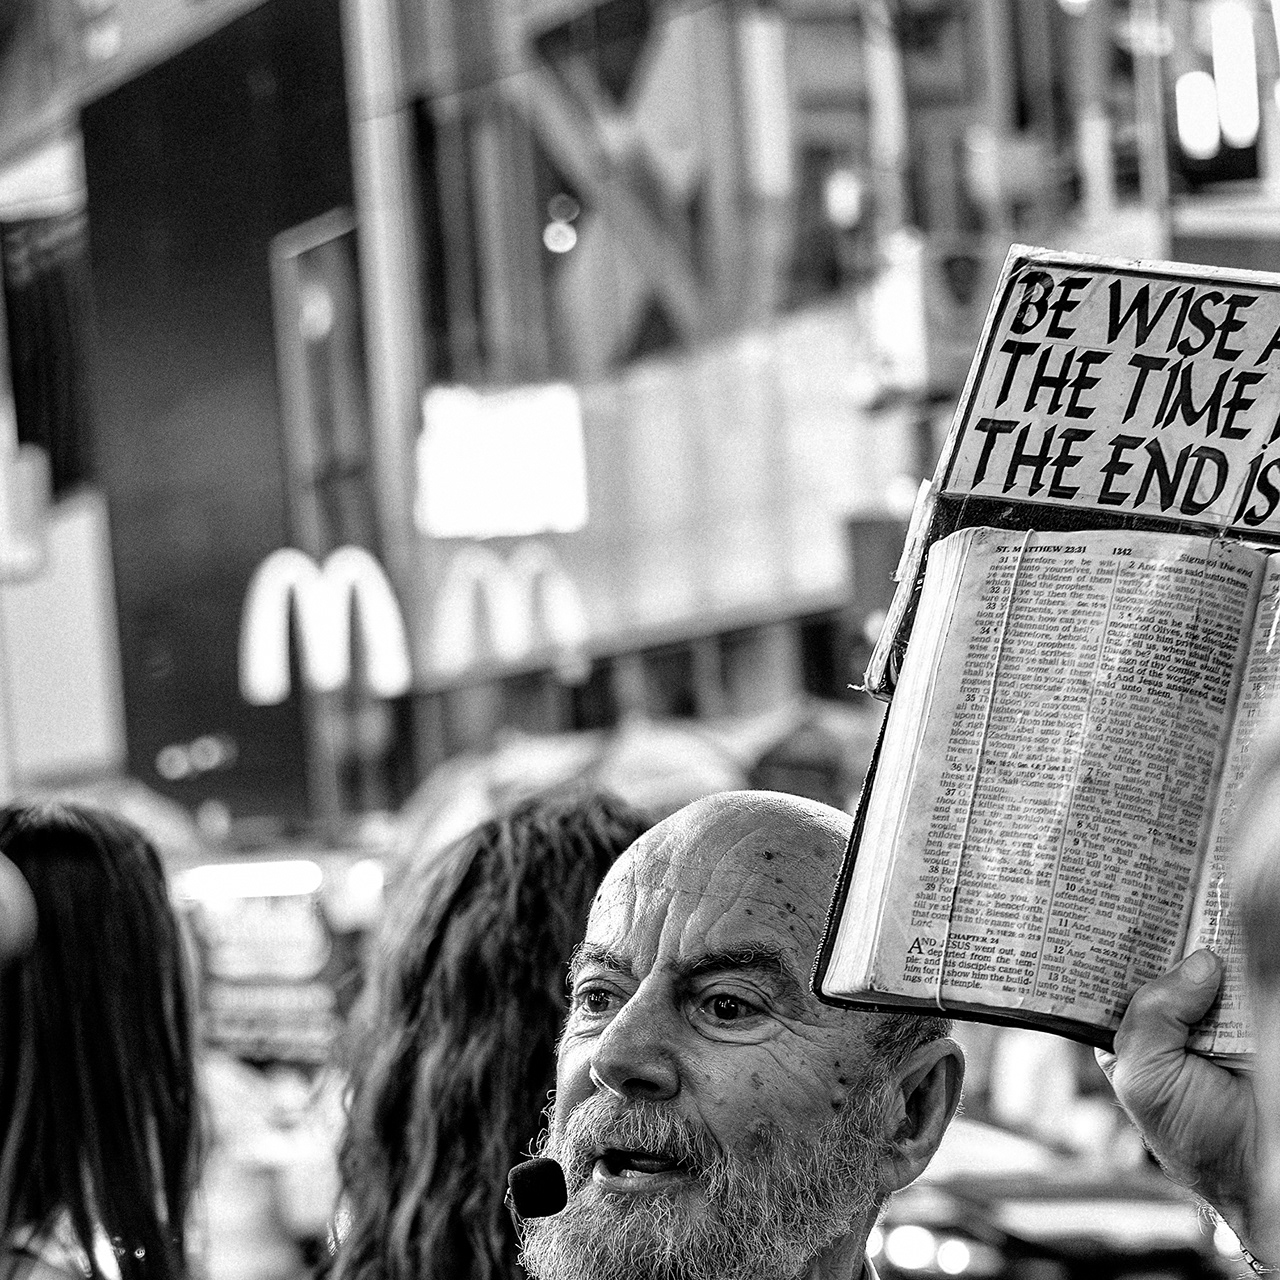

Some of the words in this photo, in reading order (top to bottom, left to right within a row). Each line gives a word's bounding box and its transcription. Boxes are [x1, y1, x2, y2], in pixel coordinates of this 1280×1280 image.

[1010, 270, 1092, 339] BE
[1108, 278, 1257, 361] WISE
[996, 340, 1110, 417] THE
[1127, 355, 1266, 440] TIME
[970, 419, 1095, 498] THE
[1097, 435, 1228, 515] END
[1220, 562, 1235, 571] the
[1237, 568, 1253, 578] end
[1153, 625, 1182, 637] Olives,
[1122, 685, 1142, 693] unto
[1067, 883, 1076, 891] 10
[1078, 886, 1098, 896] And
[1059, 919, 1068, 927] 11
[1072, 922, 1091, 932] And
[908, 937, 936, 955] AND
[999, 948, 1015, 956] out,
[1021, 951, 1038, 959] and
[1054, 946, 1064, 954] 12
[1067, 949, 1086, 959] And
[970, 953, 991, 962] from
[997, 956, 1010, 964] the
[905, 964, 921, 973] him
[972, 971, 988, 980] him
[991, 974, 1004, 982] the
[959, 961, 996, 971] disciples
[999, 967, 1022, 975] came
[1025, 969, 1034, 977] to
[903, 974, 921, 983] ings
[951, 979, 982, 989] temple.
[1049, 973, 1059, 981] 13
